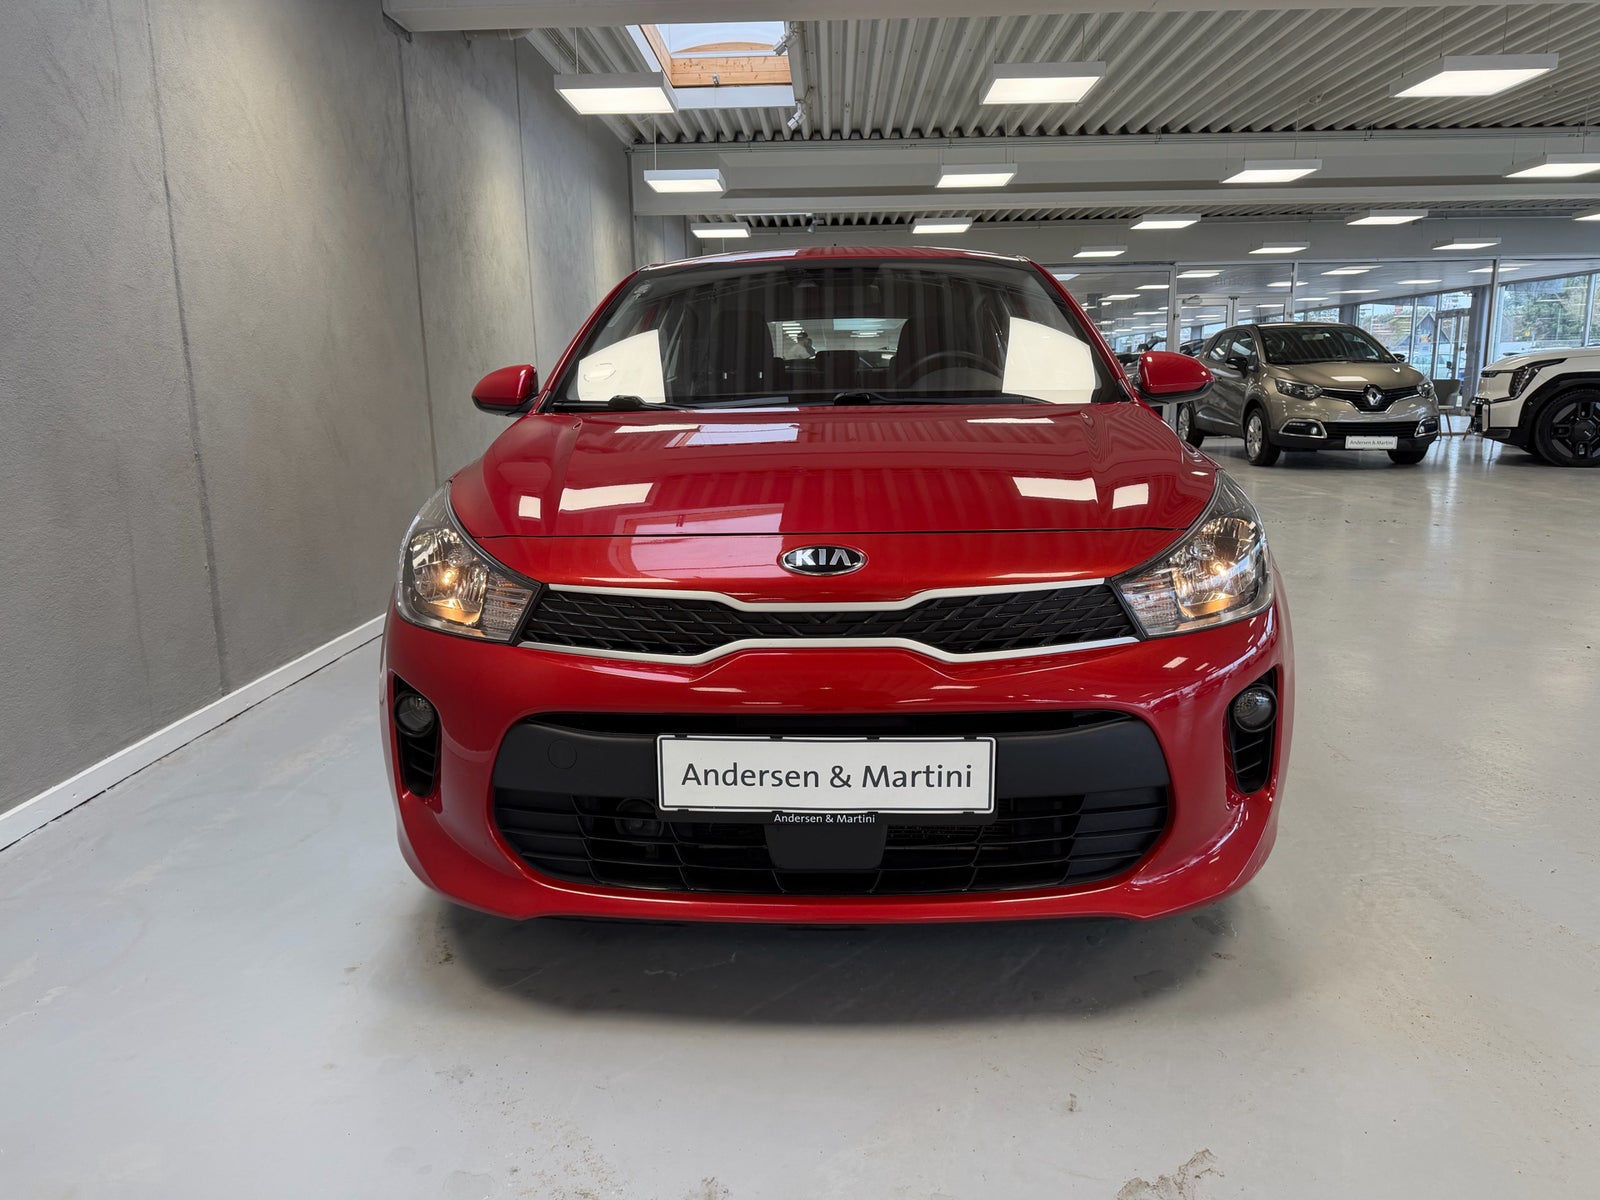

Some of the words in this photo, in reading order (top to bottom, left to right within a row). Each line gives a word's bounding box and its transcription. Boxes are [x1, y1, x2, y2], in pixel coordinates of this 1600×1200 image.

[795, 548, 852, 566] KIA
[681, 762, 820, 788] Andersen
[829, 765, 851, 788] &
[862, 765, 972, 788] Martini
[774, 814, 823, 824] Andersen
[826, 814, 834, 824] &
[837, 814, 876, 824] Martini
